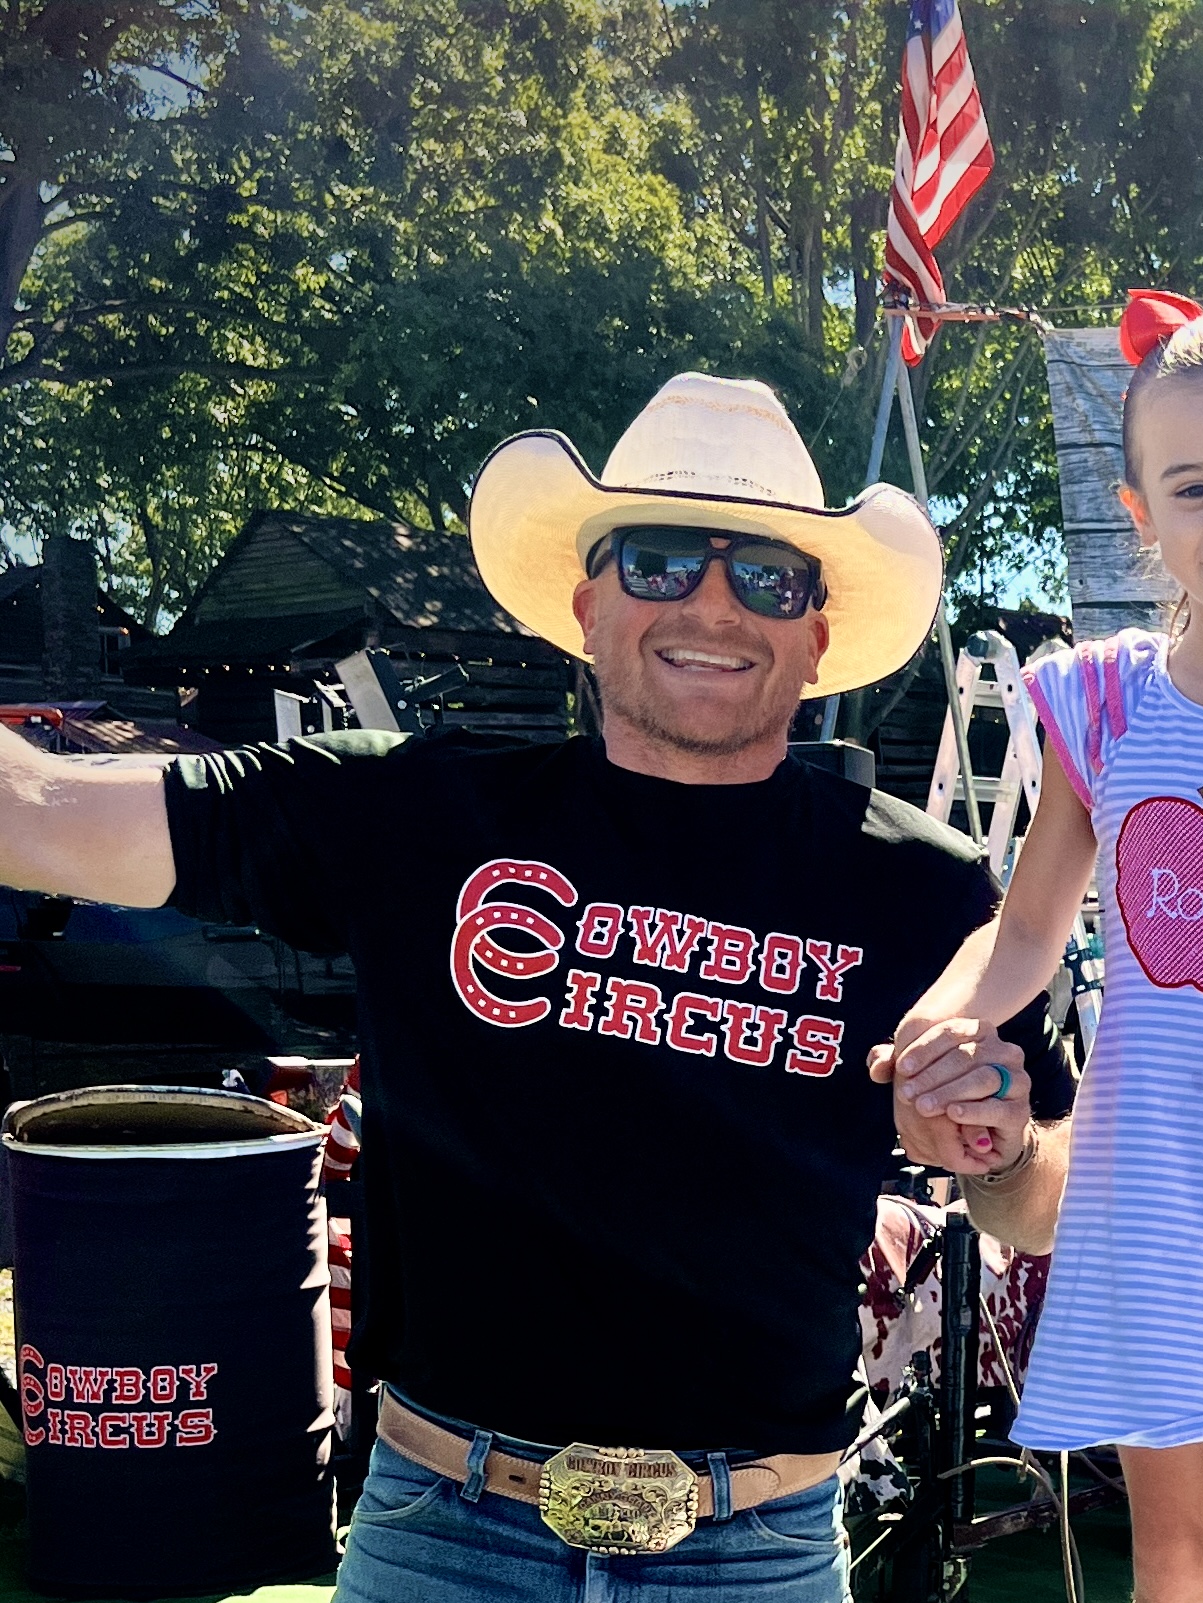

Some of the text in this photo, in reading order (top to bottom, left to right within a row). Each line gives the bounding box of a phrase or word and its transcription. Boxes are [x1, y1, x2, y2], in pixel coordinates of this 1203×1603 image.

[456, 858, 863, 1002] COWBOY
[450, 901, 844, 1077] CIRCUS
[20, 1343, 218, 1417] COWBOY
[21, 1373, 218, 1449] CIRCUS
[624, 1461, 678, 1478] CIRCUS
